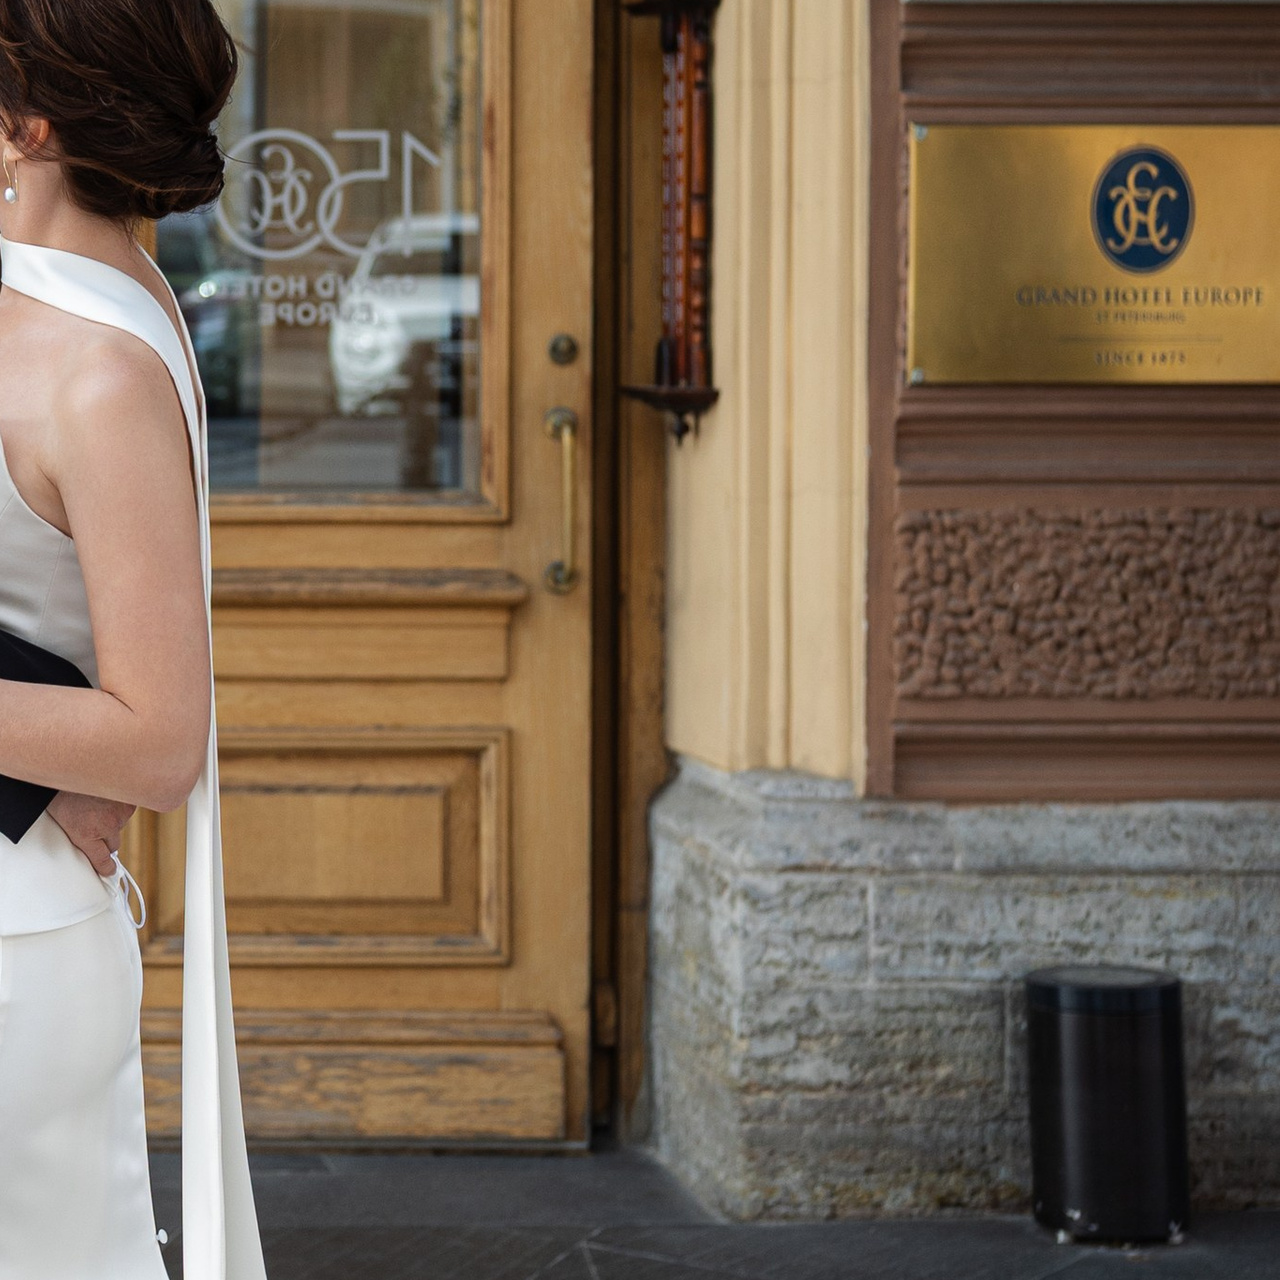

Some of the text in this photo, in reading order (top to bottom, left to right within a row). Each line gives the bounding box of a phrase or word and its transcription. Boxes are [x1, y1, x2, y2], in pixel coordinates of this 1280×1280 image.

[1015, 285, 1265, 307] GRAND HOTEL EUROPE
